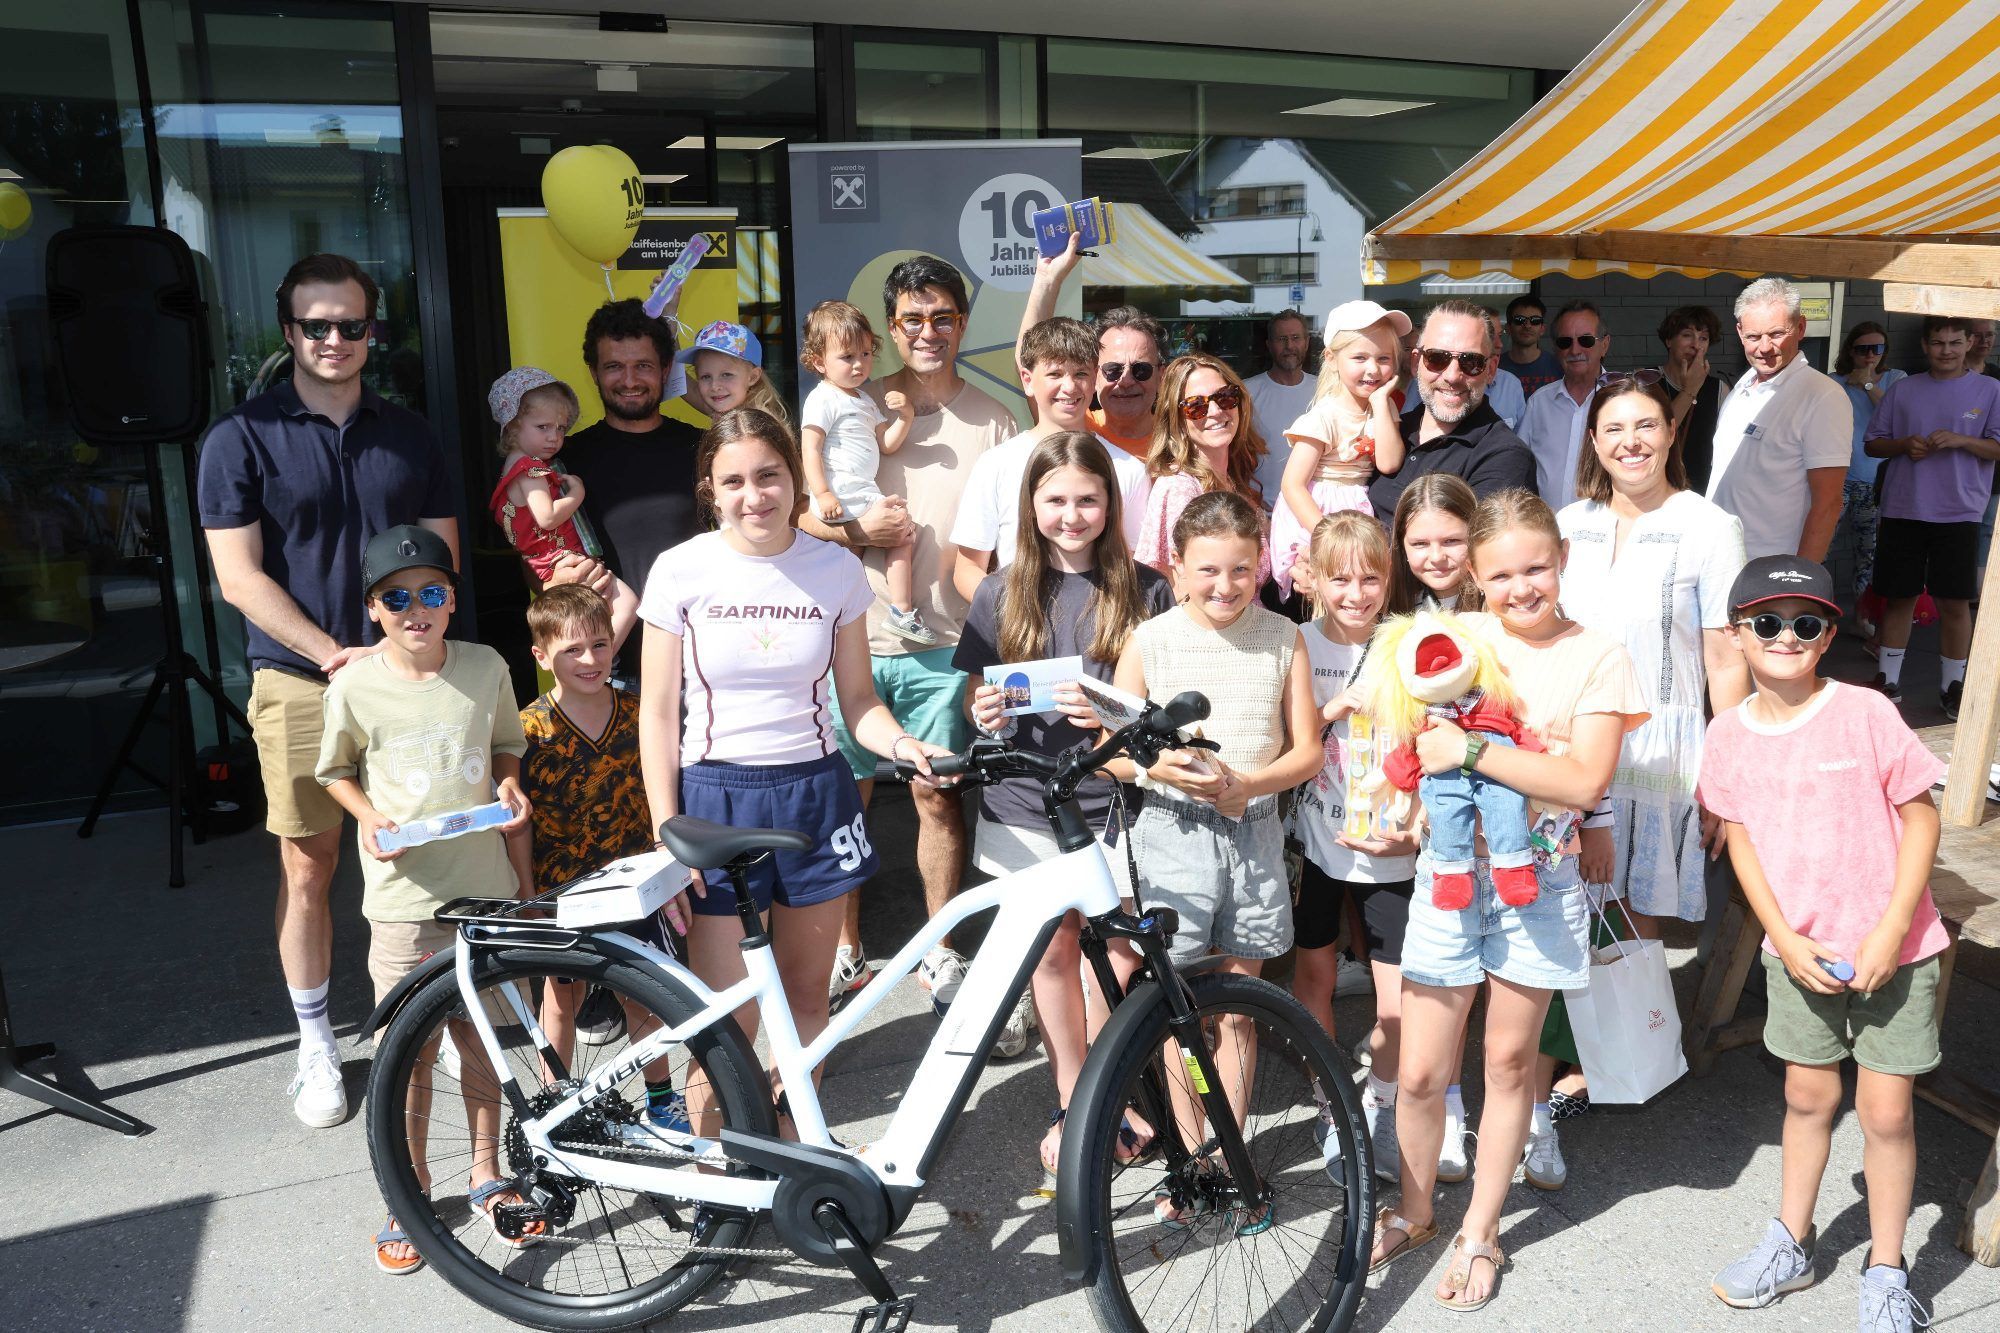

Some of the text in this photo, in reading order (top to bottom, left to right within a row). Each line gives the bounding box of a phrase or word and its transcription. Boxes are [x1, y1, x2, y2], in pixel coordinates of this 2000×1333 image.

[858, 164, 866, 172] by
[620, 175, 644, 207] 10
[625, 208, 643, 221] Jahr
[980, 189, 1051, 239] 10
[641, 248, 682, 258] am Hof
[989, 242, 1040, 262] Jahr
[990, 264, 1037, 277] Jubiläu
[1314, 667, 1351, 678] DREAMS
[830, 811, 873, 872] 98
[577, 1047, 657, 1106] CUBE
[1355, 1129, 1370, 1195] APPLE
[639, 1272, 690, 1308] APPLE
